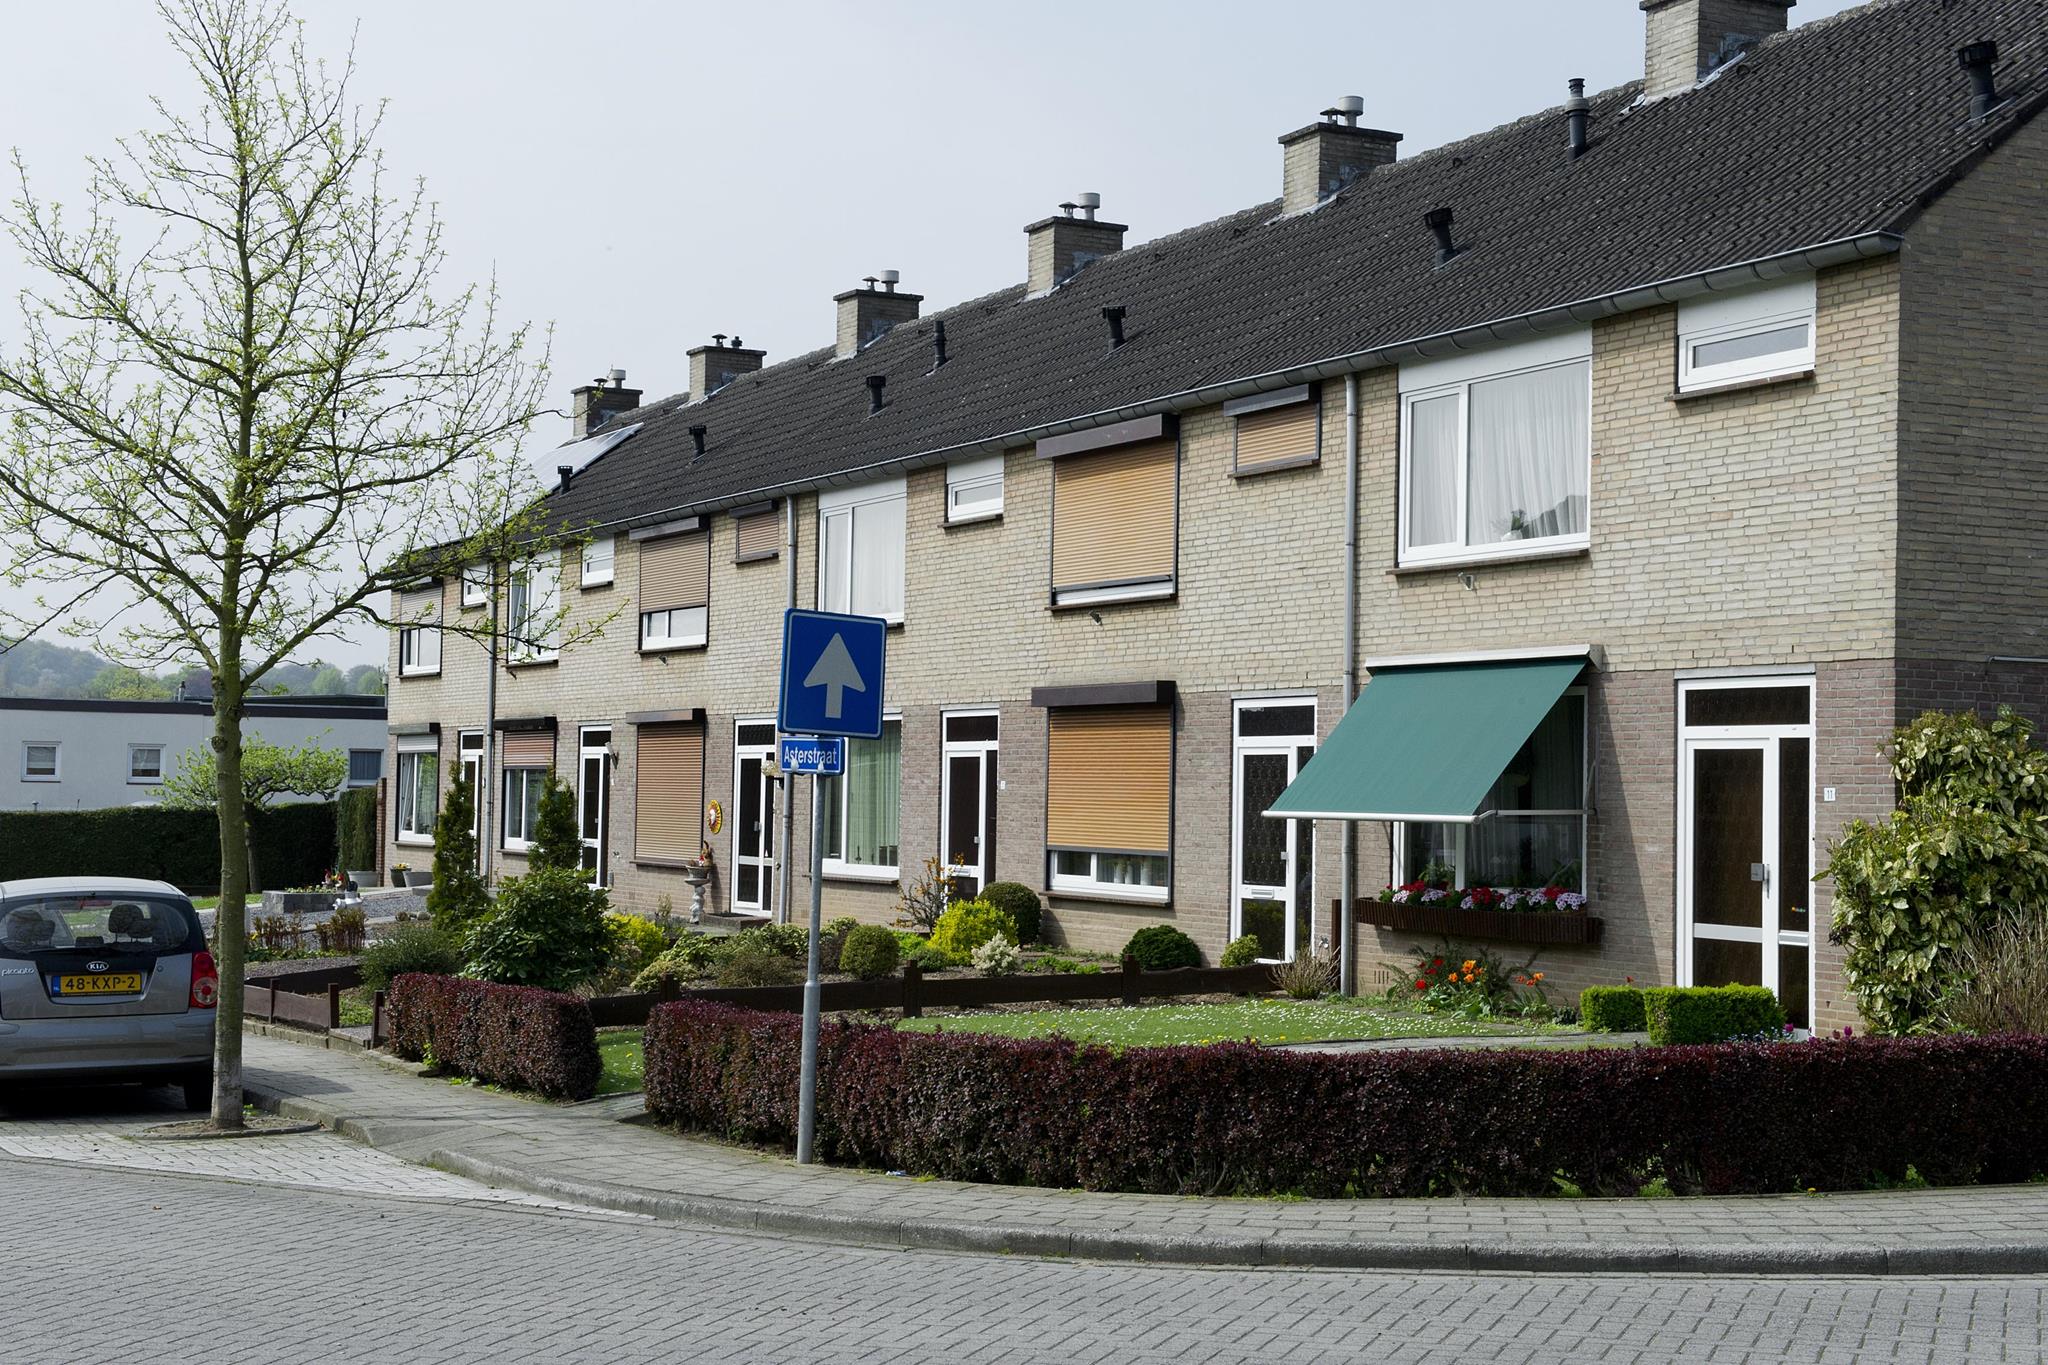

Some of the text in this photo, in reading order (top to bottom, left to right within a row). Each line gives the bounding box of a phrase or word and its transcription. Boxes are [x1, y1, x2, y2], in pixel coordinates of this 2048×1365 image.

[784, 745, 837, 765] Asterstraat
[1827, 789, 1833, 799] 11
[65, 976, 136, 990] 48-KXP-2
